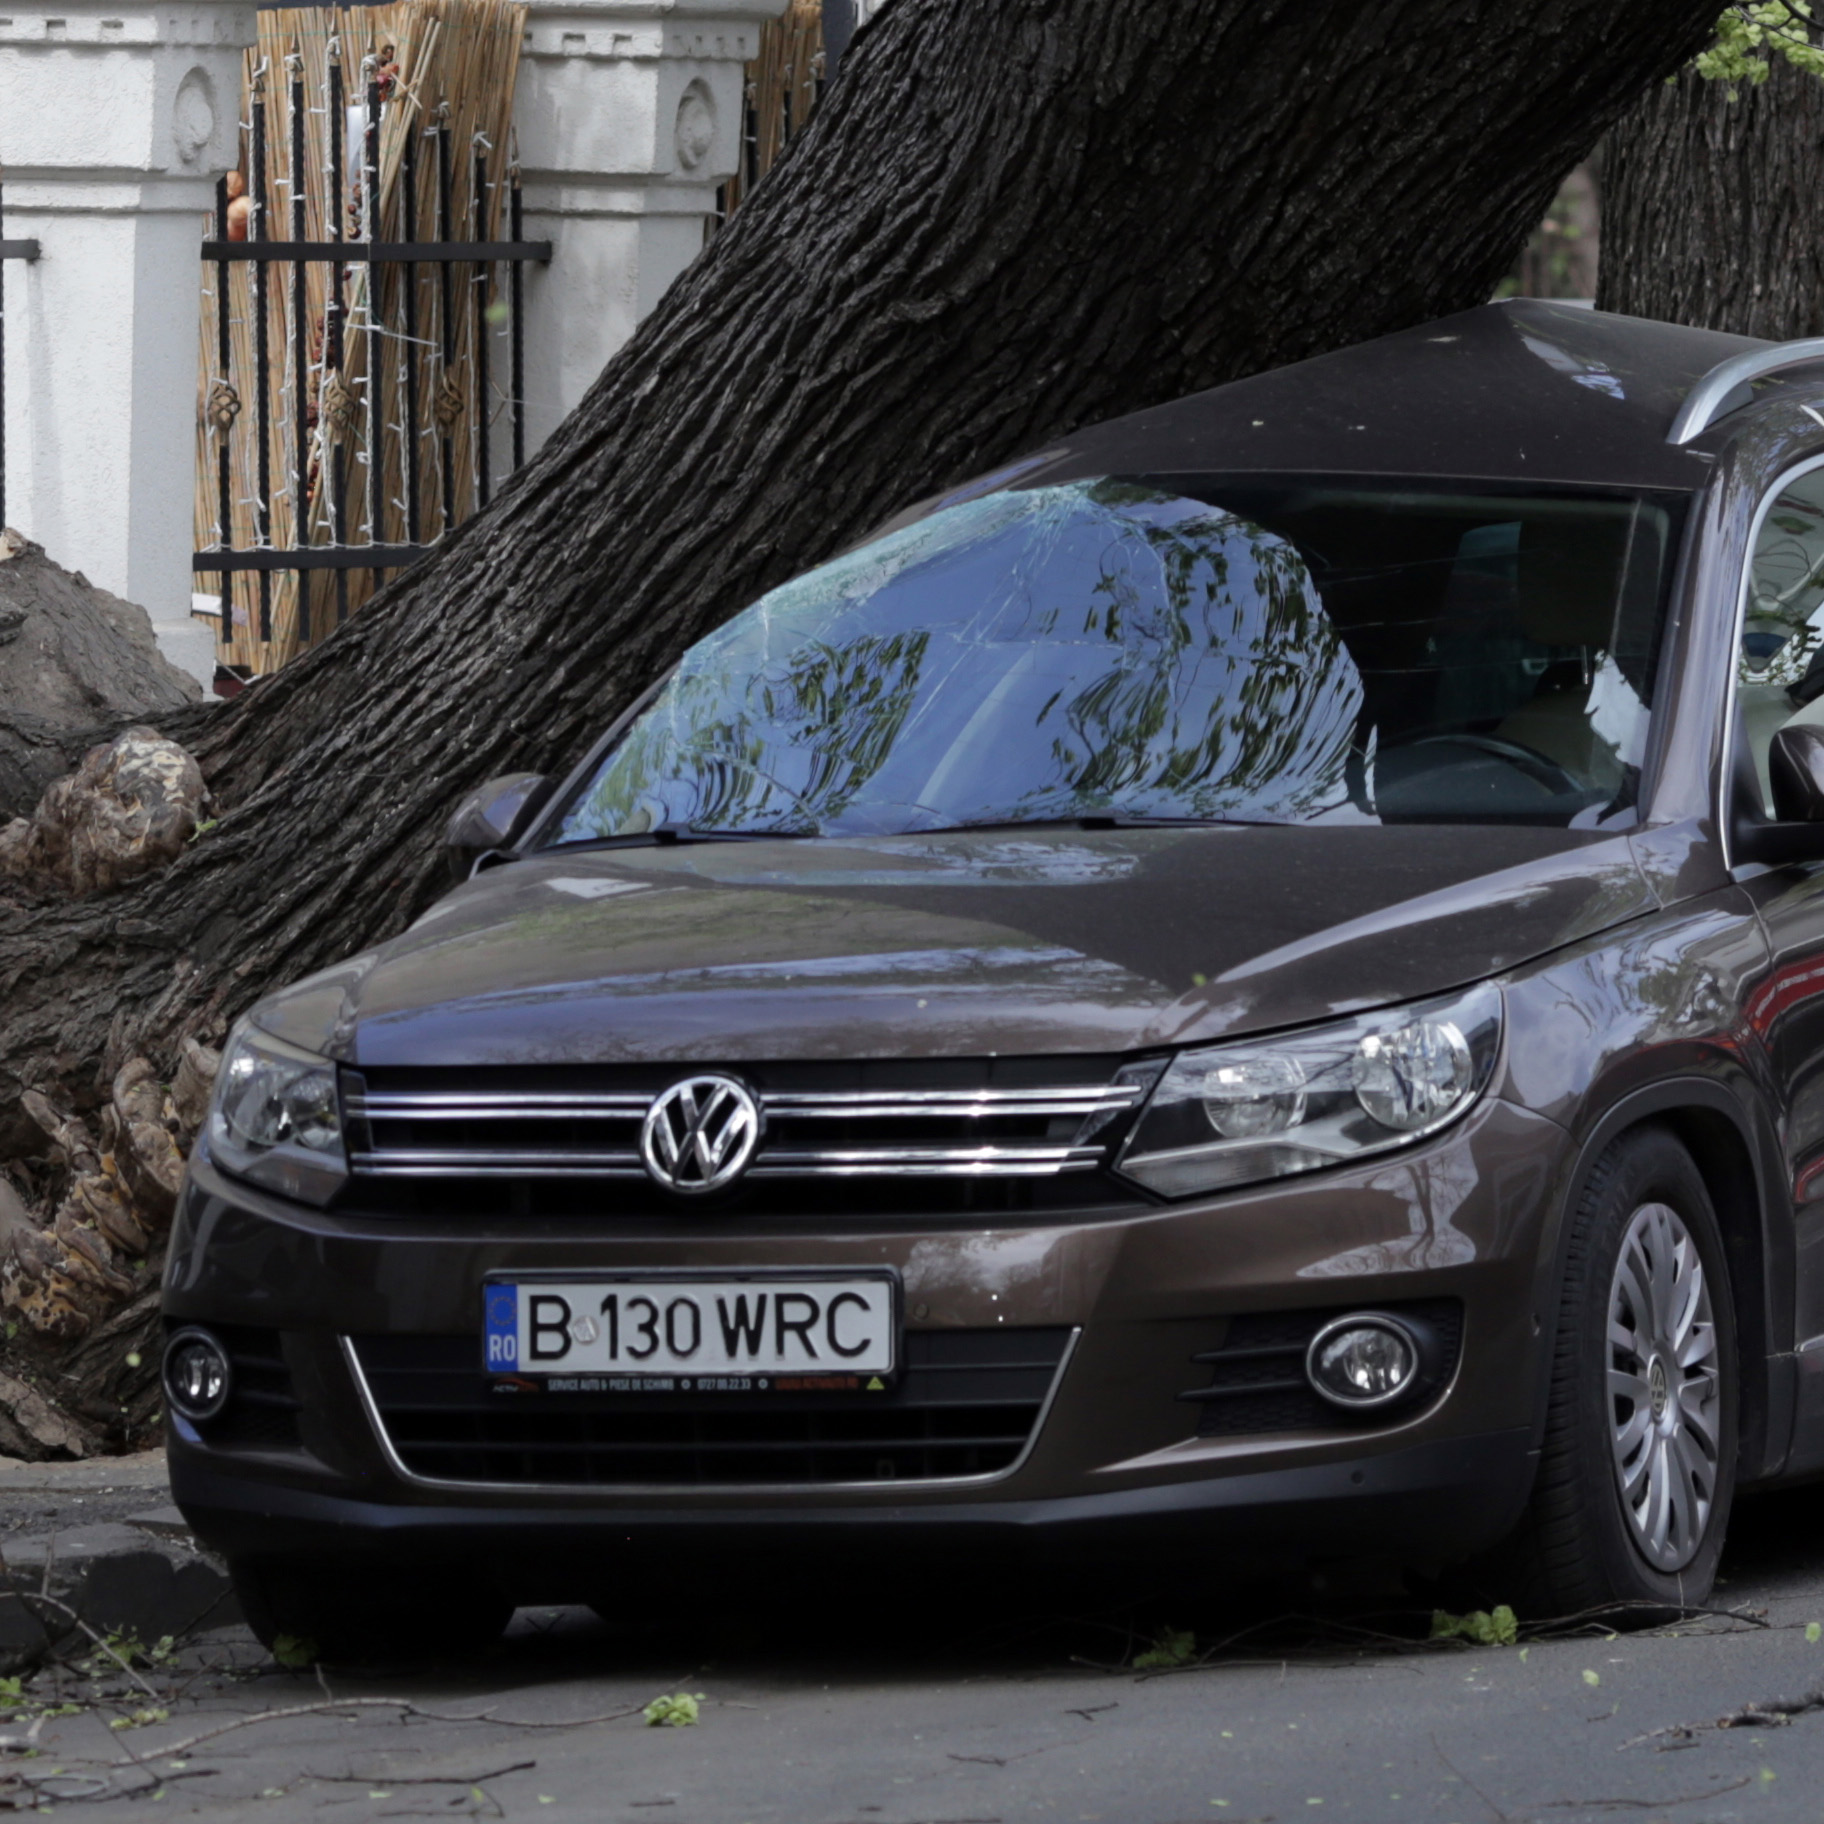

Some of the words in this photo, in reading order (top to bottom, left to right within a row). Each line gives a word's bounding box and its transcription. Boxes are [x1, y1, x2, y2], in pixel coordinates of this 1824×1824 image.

[529, 1294, 572, 1361] B
[600, 1293, 702, 1361] 130
[716, 1292, 873, 1360] WRC
[489, 1334, 517, 1362] RO
[580, 1379, 599, 1391] AUTO
